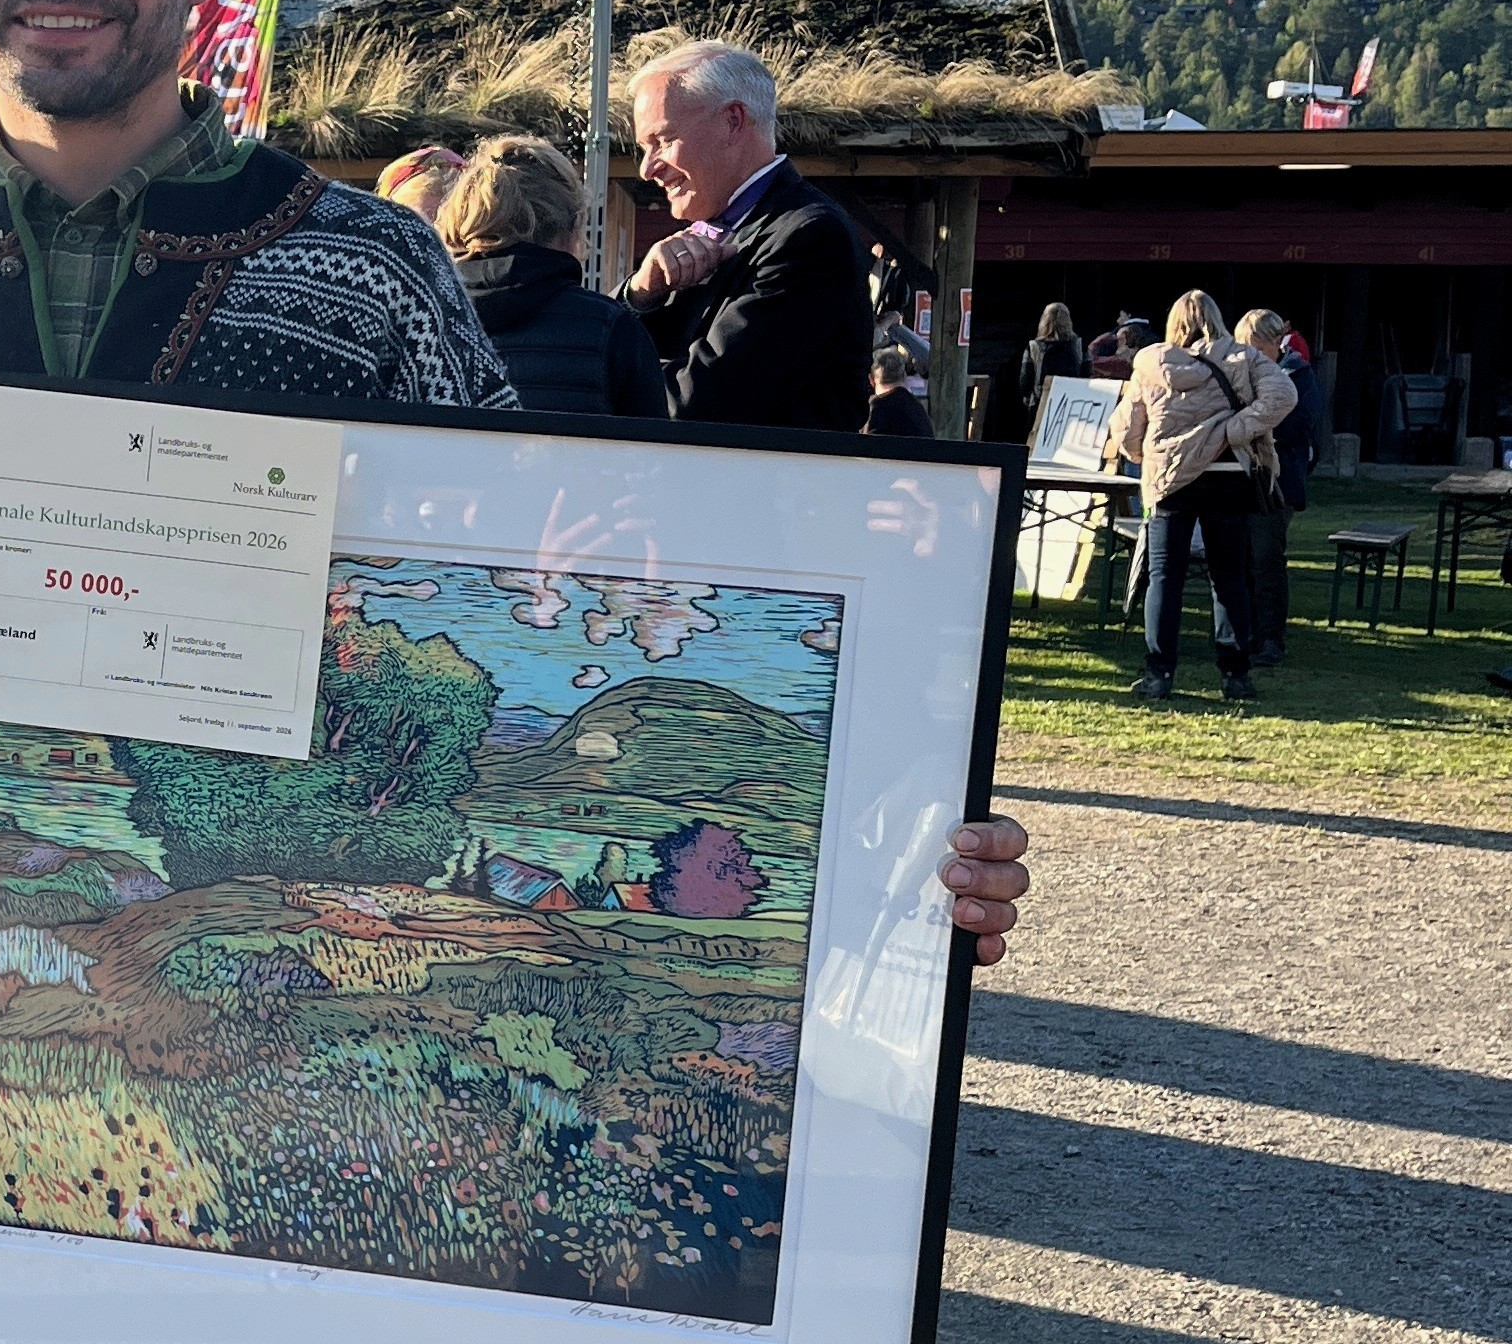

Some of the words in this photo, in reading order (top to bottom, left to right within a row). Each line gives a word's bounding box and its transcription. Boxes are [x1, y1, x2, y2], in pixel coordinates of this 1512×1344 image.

[157, 447, 229, 462] matdepartementet
[202, 442, 213, 452] og
[232, 482, 264, 496] Norsk
[267, 486, 318, 502] Kulturarv
[39, 506, 242, 545] Kulturlandskapsprisen
[246, 530, 288, 551] 2026
[44, 568, 73, 591] 50
[81, 572, 140, 602] 000,-
[216, 641, 226, 650] og
[171, 646, 243, 661] matdepartementet
[238, 722, 273, 733] september
[275, 726, 292, 736] 2026
